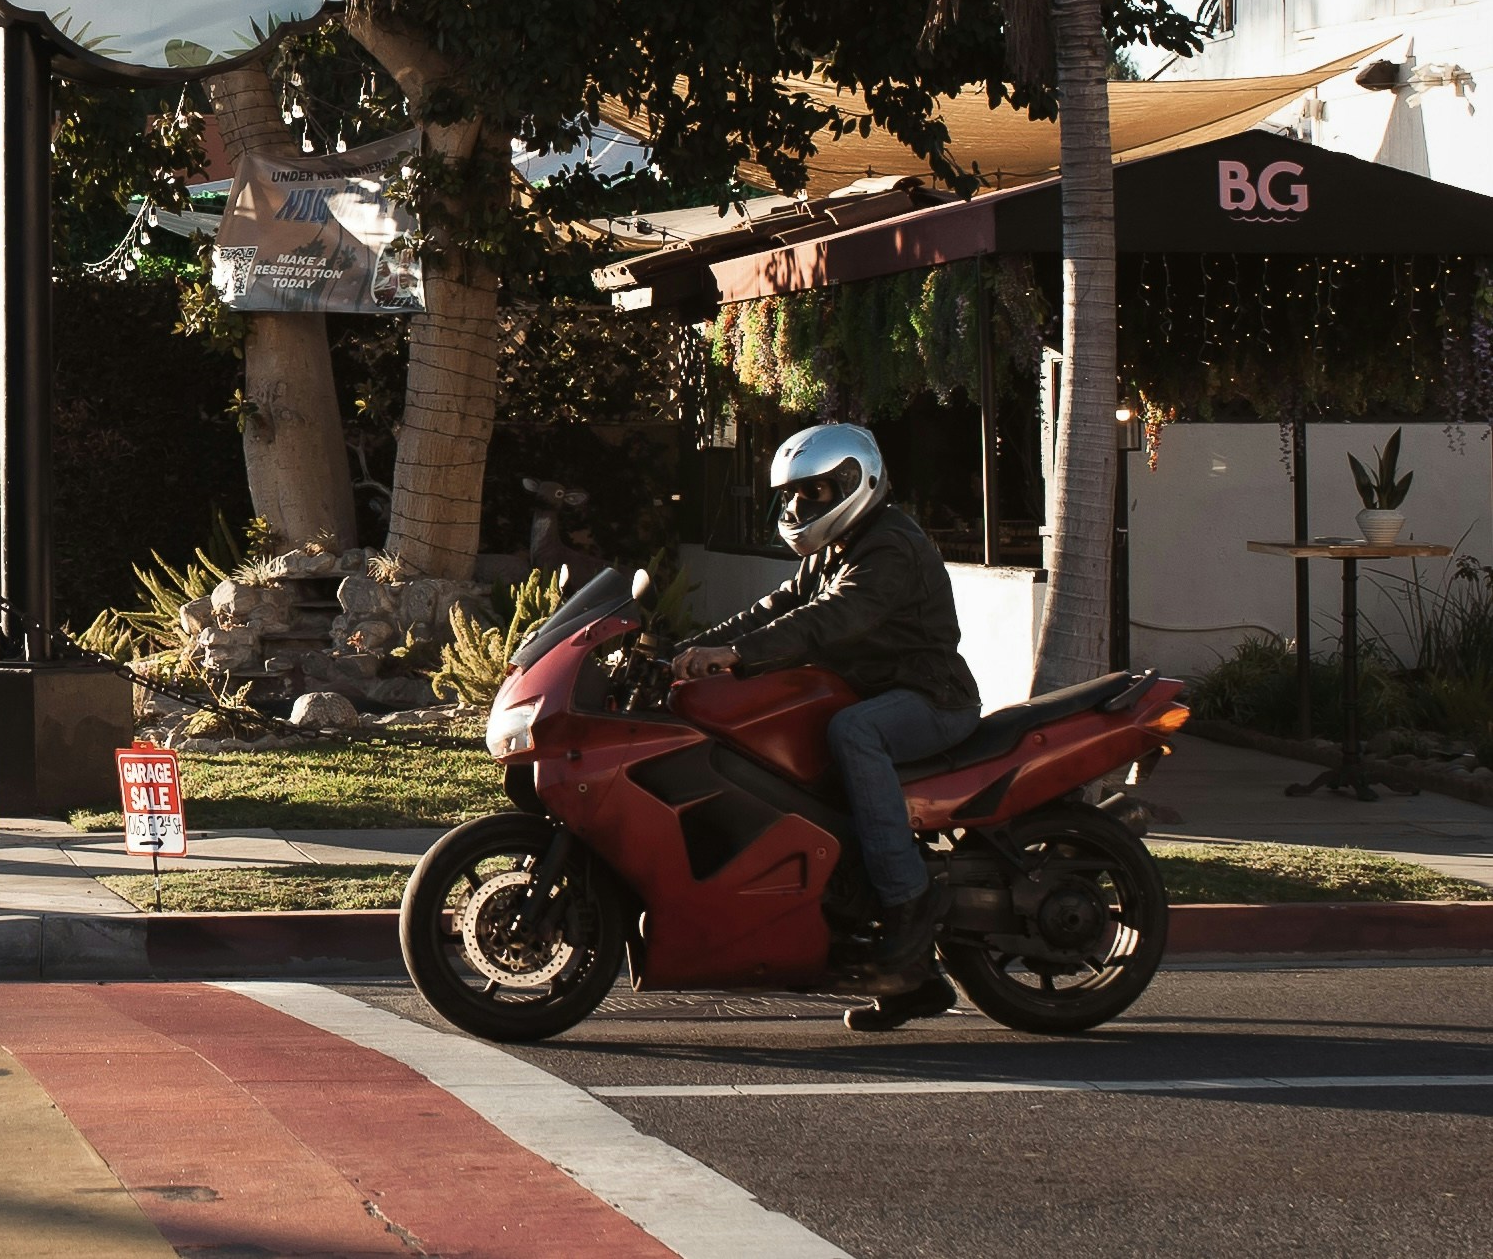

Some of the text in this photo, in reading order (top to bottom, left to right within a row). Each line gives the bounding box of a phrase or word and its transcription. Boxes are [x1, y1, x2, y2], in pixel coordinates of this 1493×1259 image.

[271, 170, 314, 183] UNDER
[341, 157, 399, 179] OWNERSHI
[1218, 160, 1309, 212] BG
[277, 253, 327, 267] MAKE A
[253, 265, 343, 280] RESERVATION
[272, 277, 315, 289] TODAY
[123, 762, 173, 784] GARAGE
[130, 786, 172, 811] SALE
[173, 816, 182, 835] St
